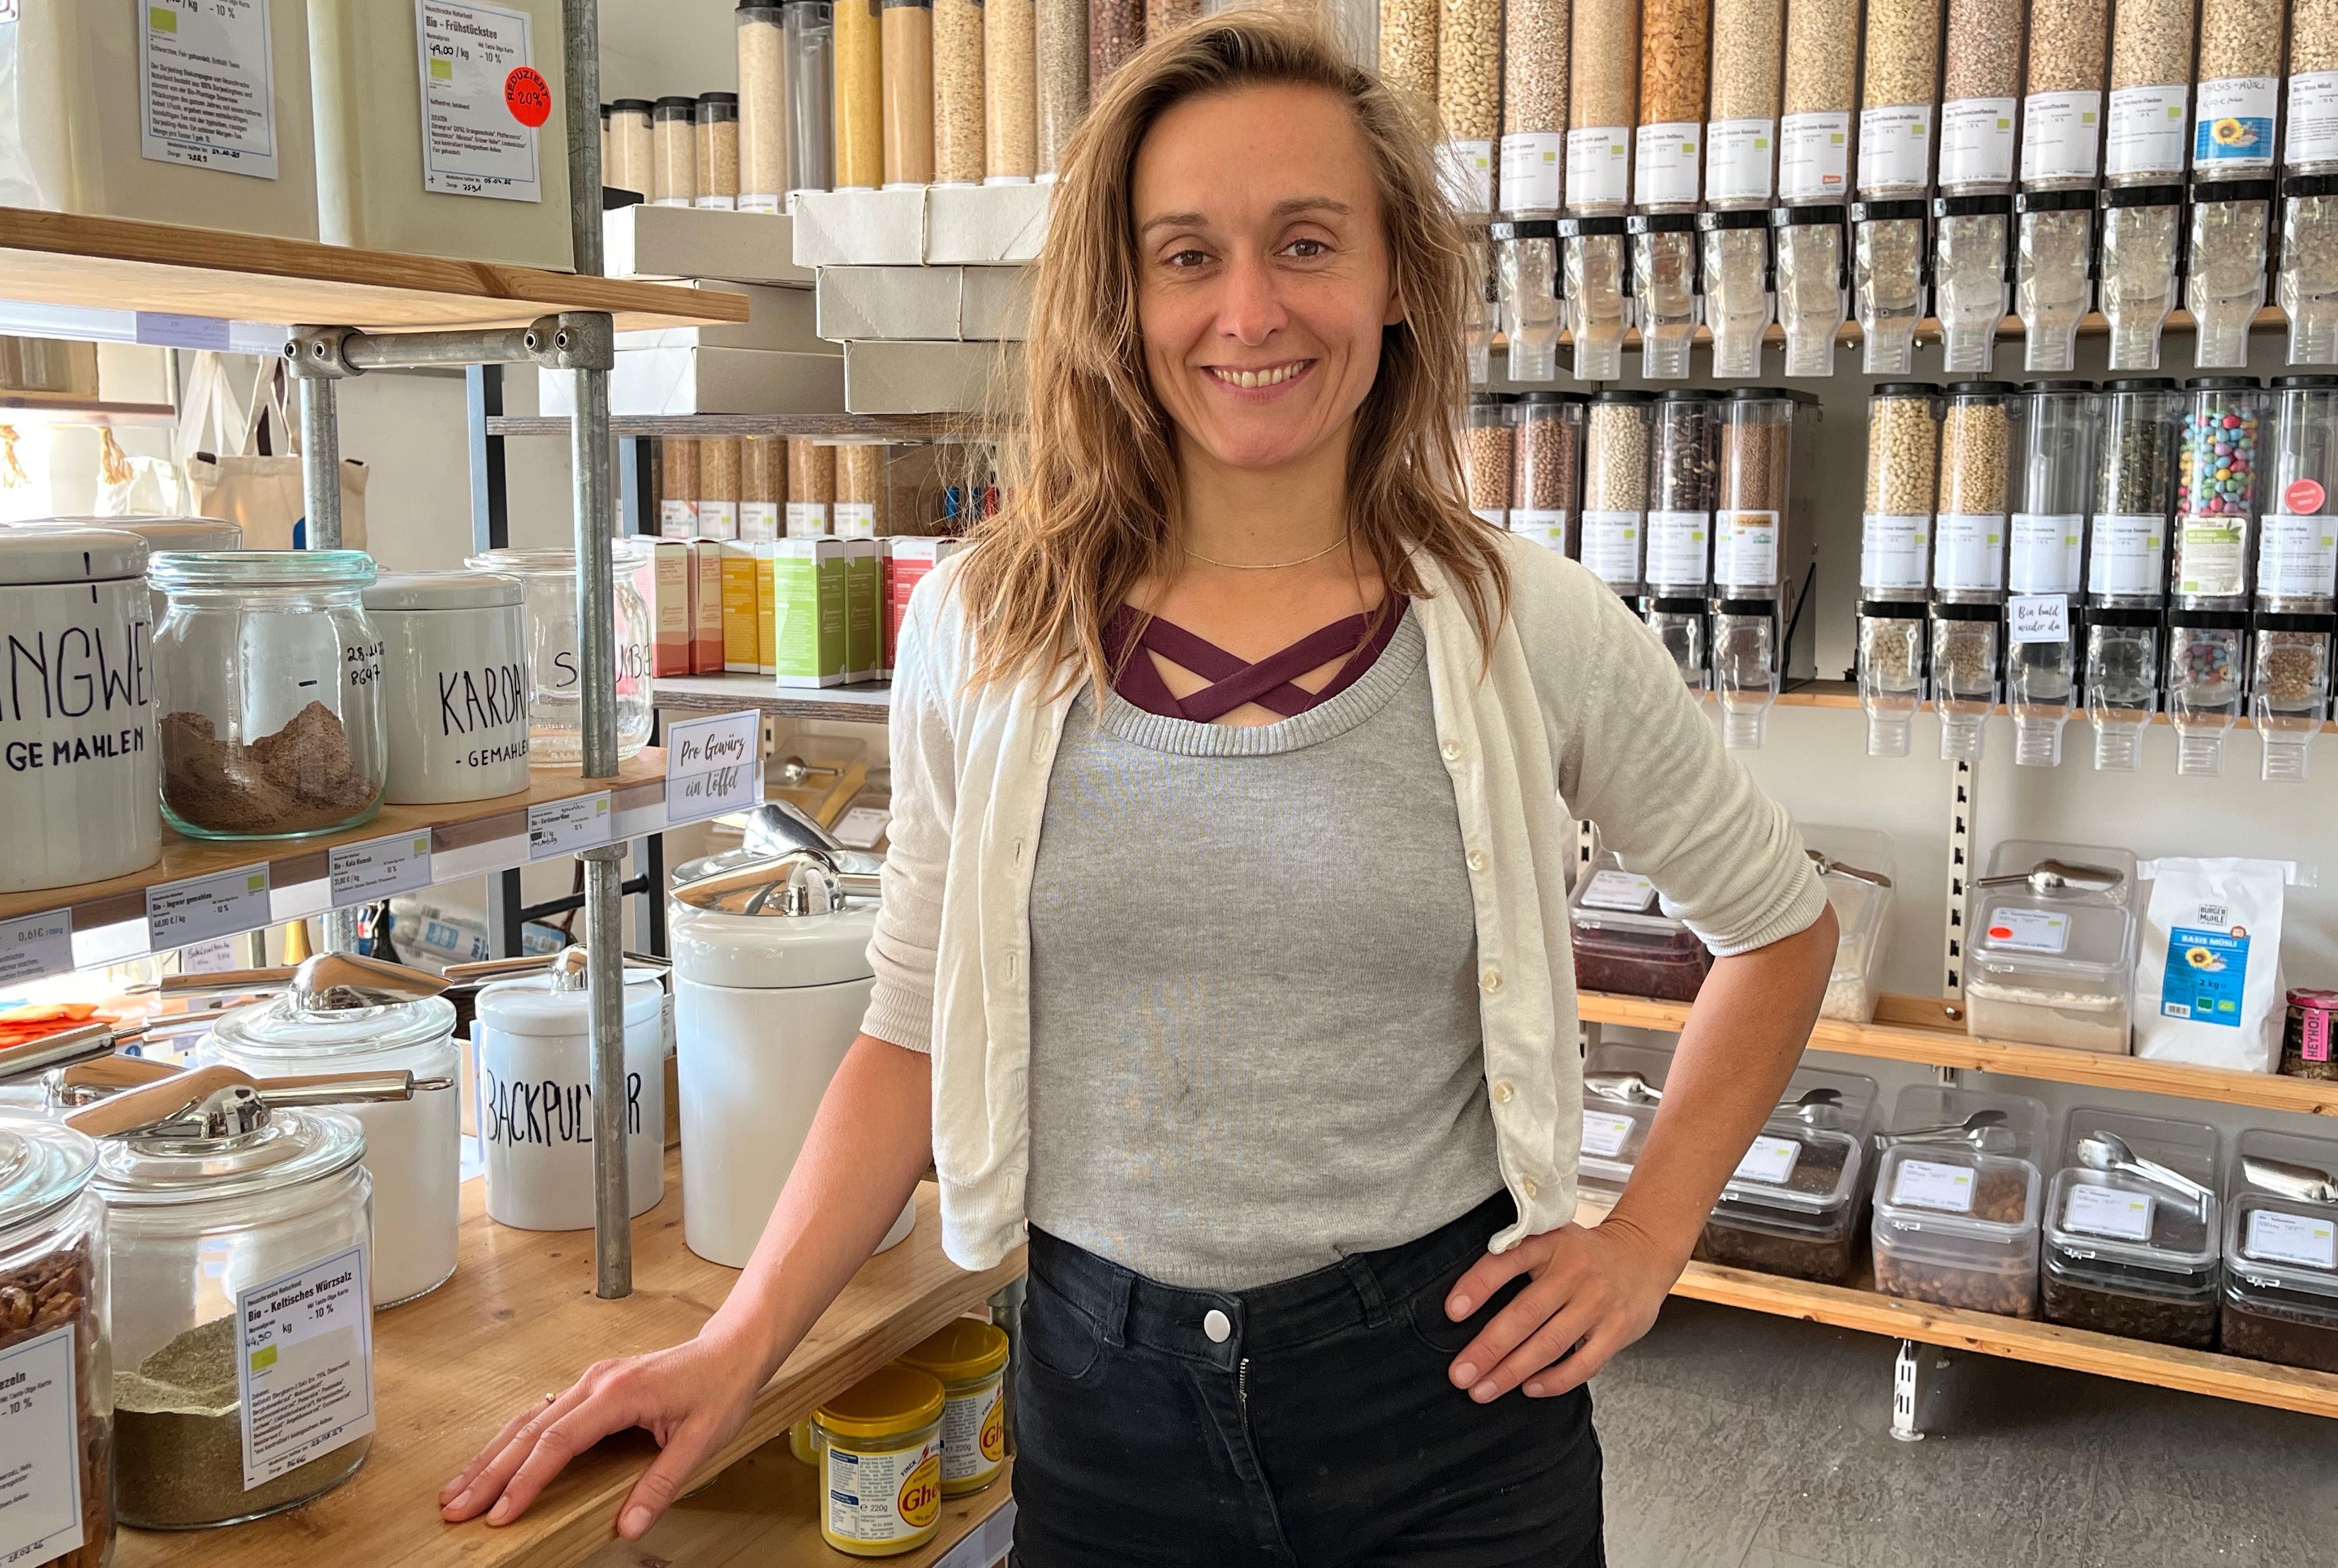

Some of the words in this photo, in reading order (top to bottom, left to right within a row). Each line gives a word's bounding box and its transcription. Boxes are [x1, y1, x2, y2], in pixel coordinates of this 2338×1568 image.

[216, 5, 225, 16] 10
[228, 7, 235, 19] %
[426, 16, 437, 28] Bio
[445, 19, 497, 40] Frühstückstee
[461, 47, 469, 60] kg
[485, 51, 494, 62] 10
[495, 53, 501, 63] %
[507, 70, 549, 101] REDUZIERT
[518, 91, 542, 107] 20%
[2018, 606, 2034, 619] Bin
[2018, 621, 2045, 632] wieder
[2048, 621, 2060, 632] da
[351, 663, 381, 686] 8647
[681, 740, 701, 767] Pro
[704, 734, 746, 761] Gewürz
[686, 781, 703, 797] ein
[706, 766, 739, 797] Löffel
[345, 859, 355, 867] Kala
[2181, 934, 2207, 945] BASIS
[2209, 937, 2237, 947] MÜSLI
[2208, 979, 2220, 990] kg
[2307, 1017, 2320, 1057] HEYHO!
[248, 1307, 261, 1322] Bio
[271, 1285, 313, 1313] Keltisches
[316, 1269, 352, 1294] Würzsalz
[282, 1321, 292, 1335] kg
[316, 1306, 324, 1319] 10
[327, 1303, 333, 1314] %
[9, 1401, 20, 1414] 10
[23, 1397, 32, 1409] %
[956, 1444, 971, 1452] 220g
[901, 1460, 917, 1477] FINCK
